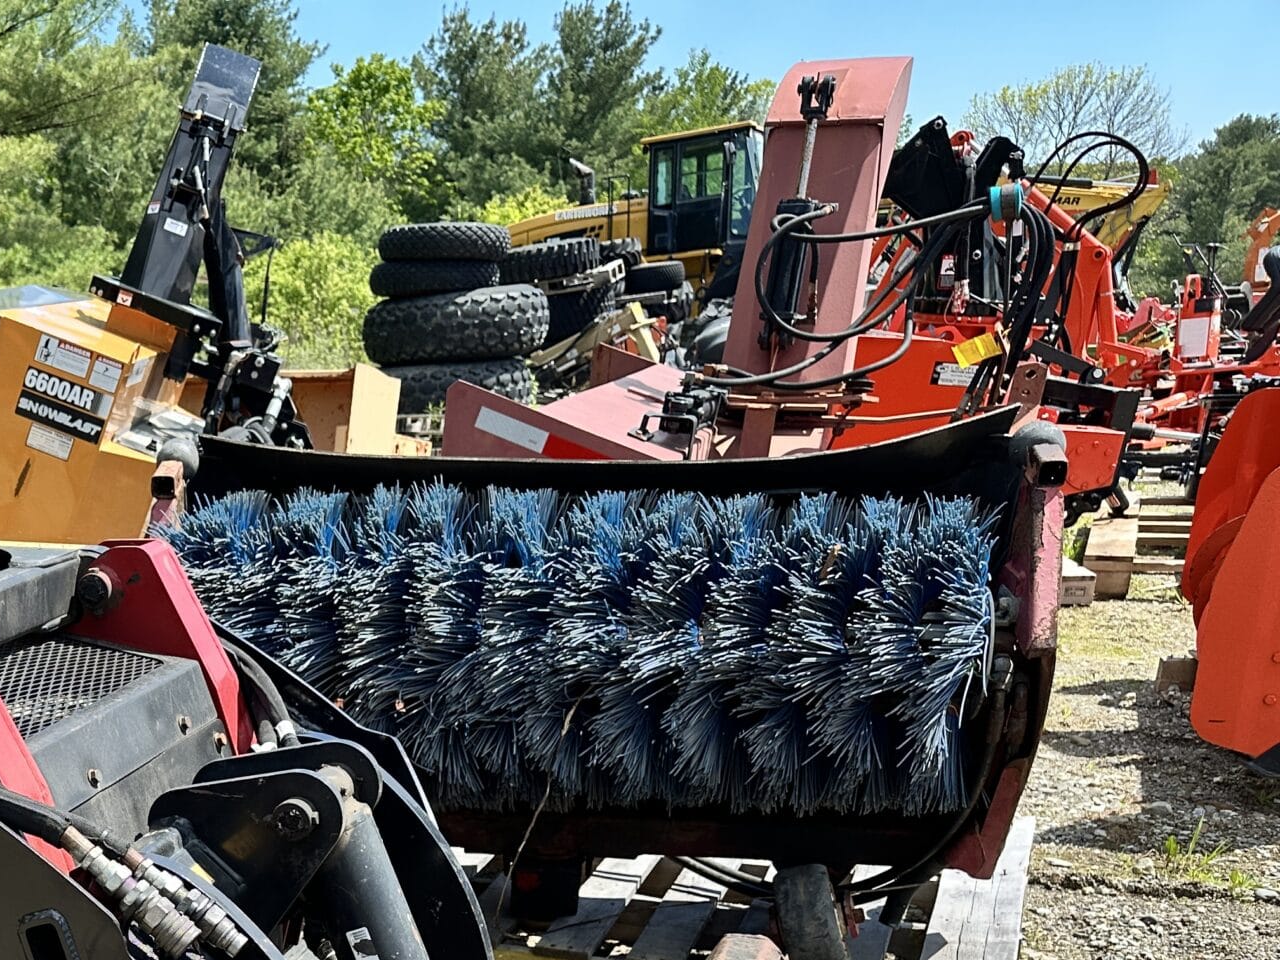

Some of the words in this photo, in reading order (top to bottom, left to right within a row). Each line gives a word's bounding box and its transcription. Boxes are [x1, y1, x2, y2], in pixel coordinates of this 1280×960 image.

[1050, 196, 1080, 206] MAR
[24, 368, 95, 410] 6600AR
[18, 397, 102, 436] SNOWBLAST
